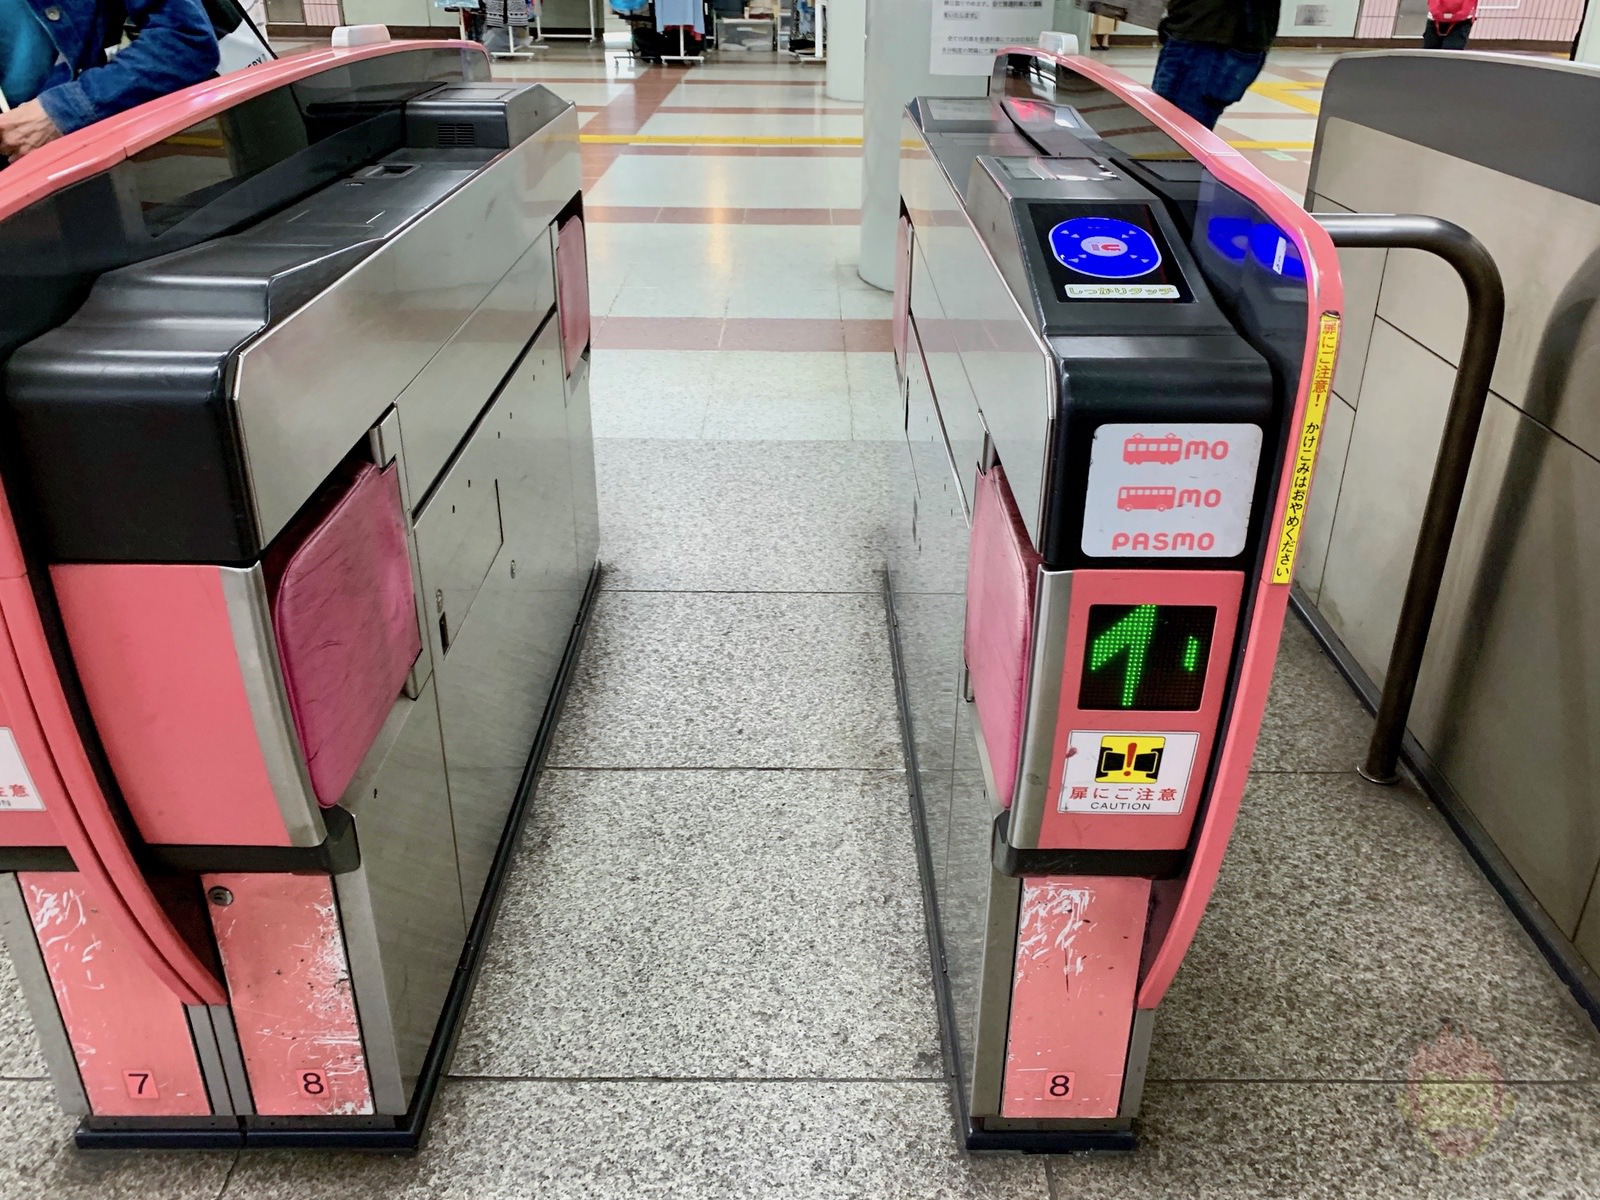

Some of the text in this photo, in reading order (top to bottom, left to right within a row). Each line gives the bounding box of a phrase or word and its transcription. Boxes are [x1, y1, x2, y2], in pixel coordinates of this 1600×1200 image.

[1275, 421, 1321, 578] かけこみはおやめください
[1111, 532, 1215, 551] PASMO
[1069, 786, 1178, 801] 扉にご注意
[1090, 801, 1151, 811] CAUTION
[127, 1073, 149, 1095] 7
[302, 1072, 325, 1095] 8
[1049, 1074, 1070, 1097] 8
